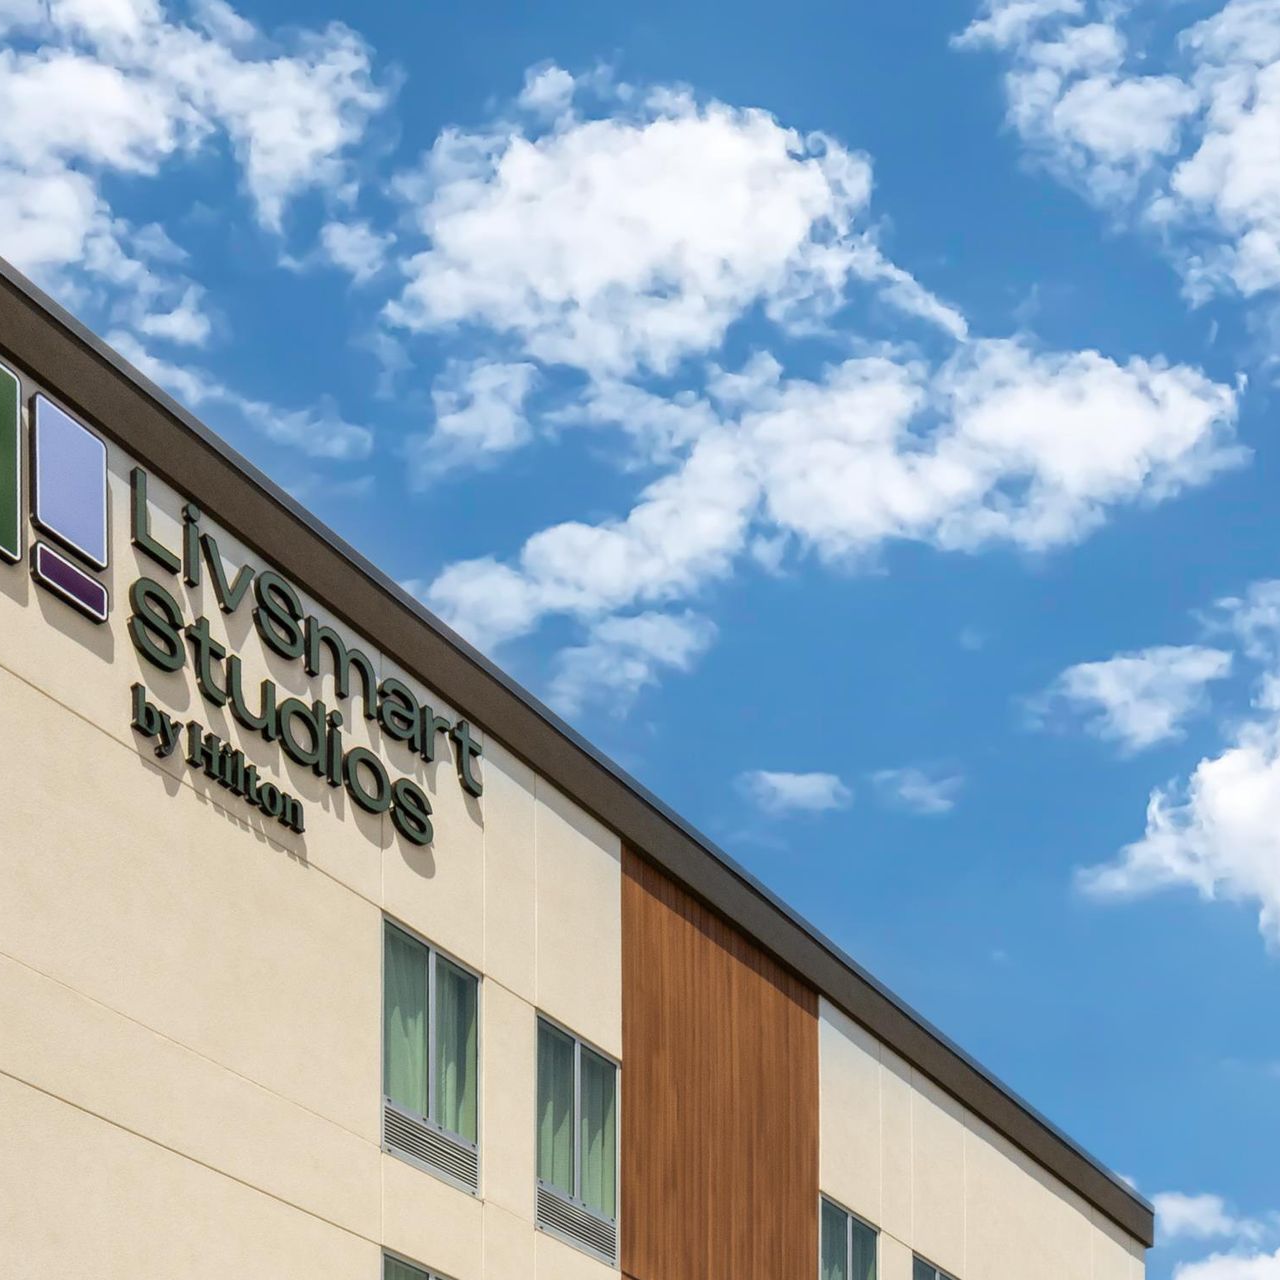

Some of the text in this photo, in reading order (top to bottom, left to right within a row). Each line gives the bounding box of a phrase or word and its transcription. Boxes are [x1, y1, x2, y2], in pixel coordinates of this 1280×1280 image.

[127, 576, 434, 846] Studios
[130, 466, 483, 798] LivSmart
[130, 682, 305, 834] by Hilton
